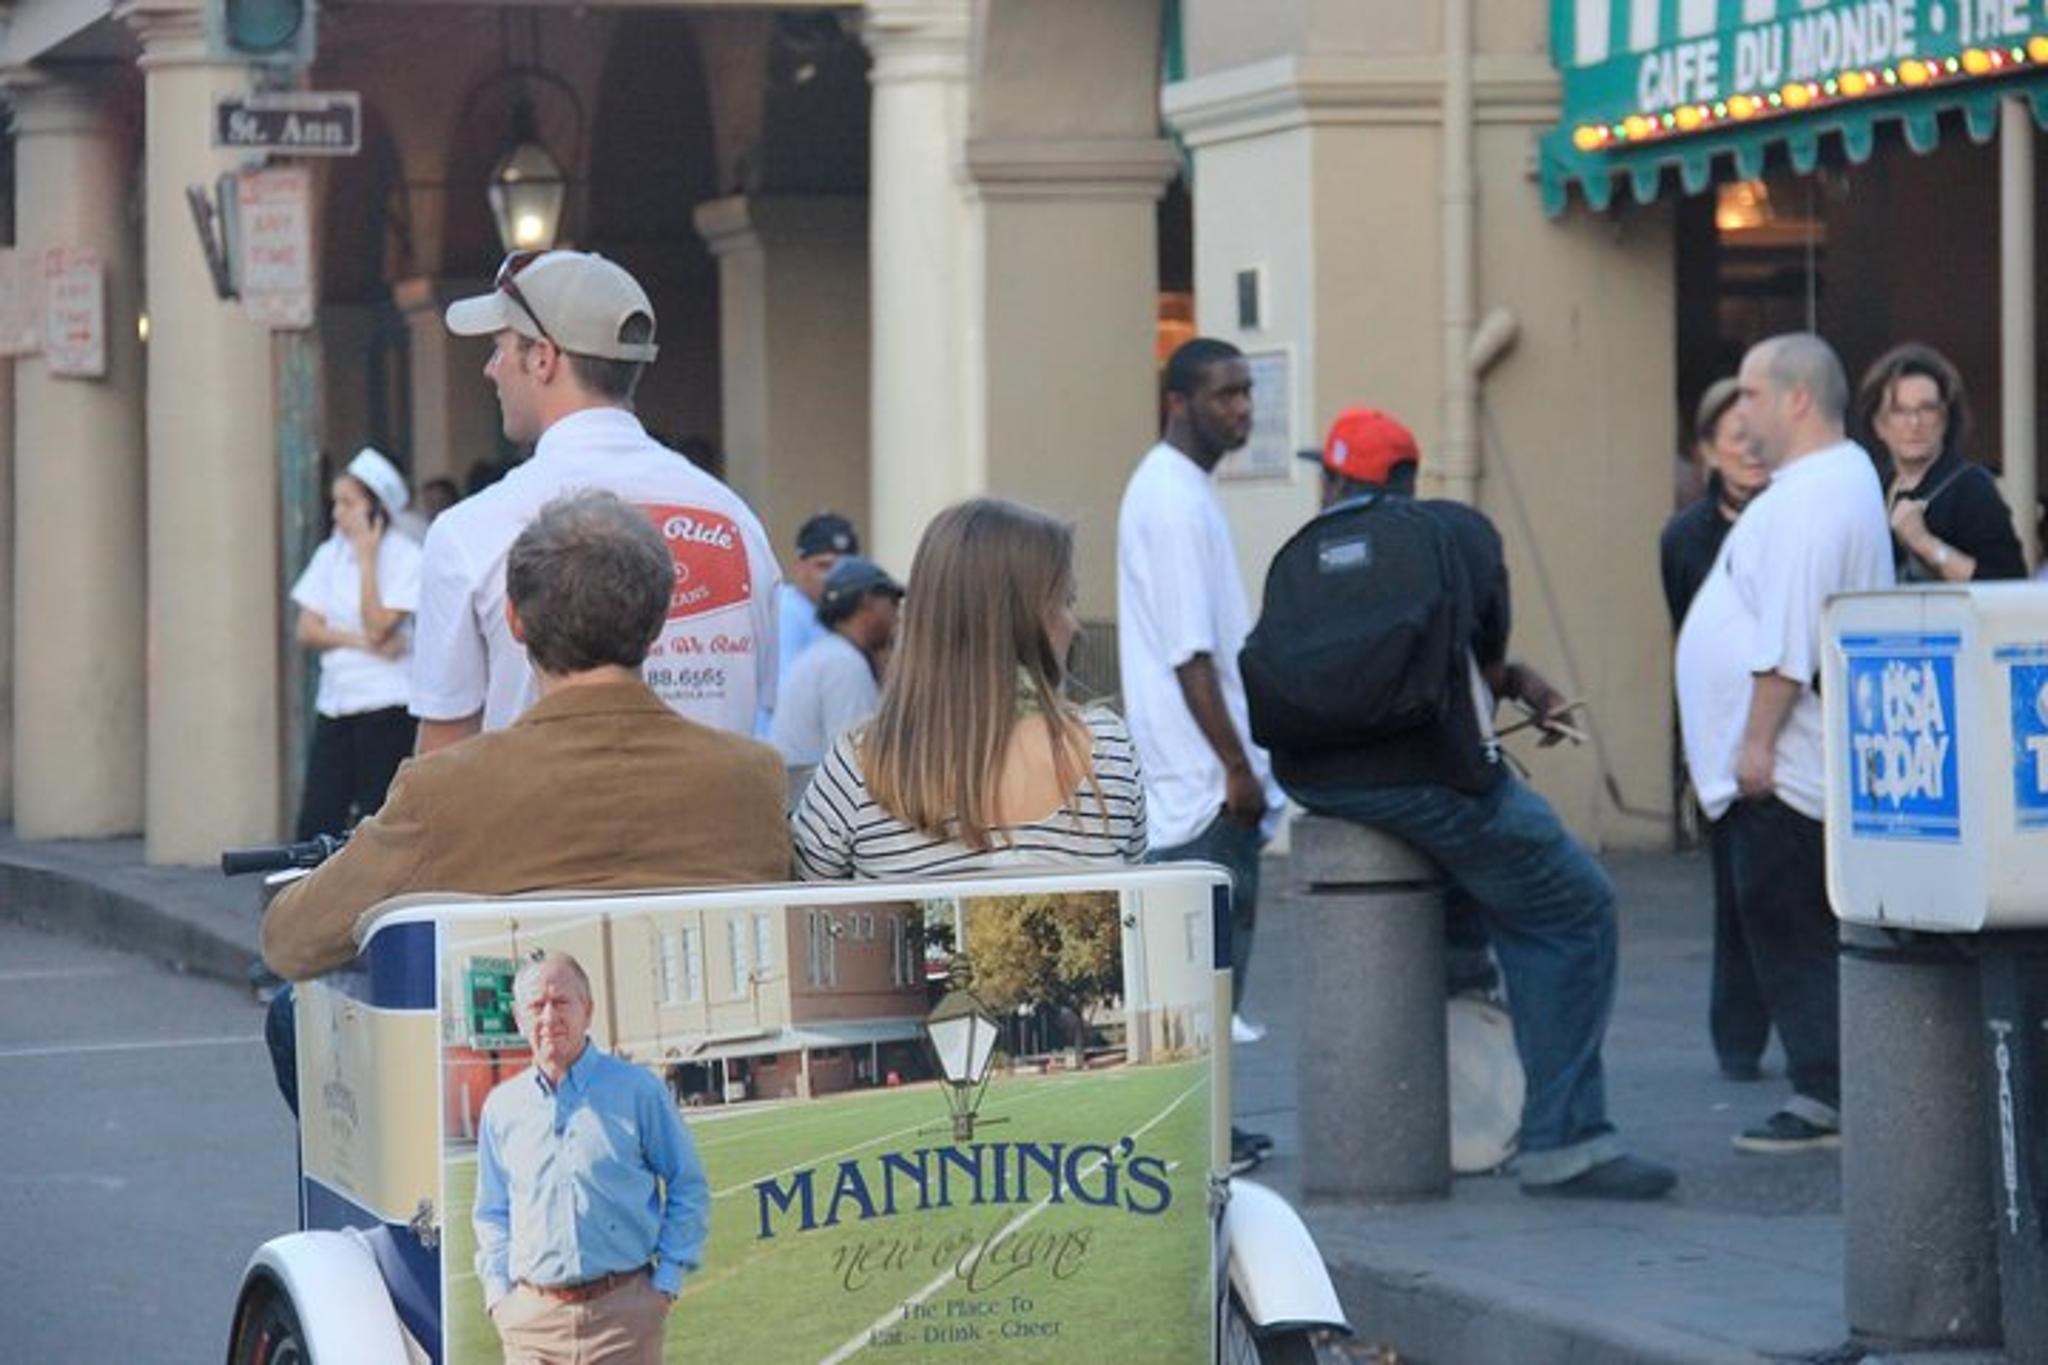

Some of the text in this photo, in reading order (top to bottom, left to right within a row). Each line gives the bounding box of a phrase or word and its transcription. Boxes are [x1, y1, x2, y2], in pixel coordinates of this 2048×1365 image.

[1637, 39, 1720, 111] CAFE
[1734, 22, 1784, 91] DU
[1789, 0, 1917, 80] MONDE
[228, 110, 345, 144] St. Ann
[663, 515, 733, 550] Ride
[1881, 659, 1947, 736] USA
[1854, 732, 1950, 803] TODAY
[752, 1135, 1174, 1240] MANNING'S
[902, 1295, 1034, 1321] The Place To
[923, 1322, 981, 1344] Drink
[1001, 1318, 1063, 1339] Cheer
